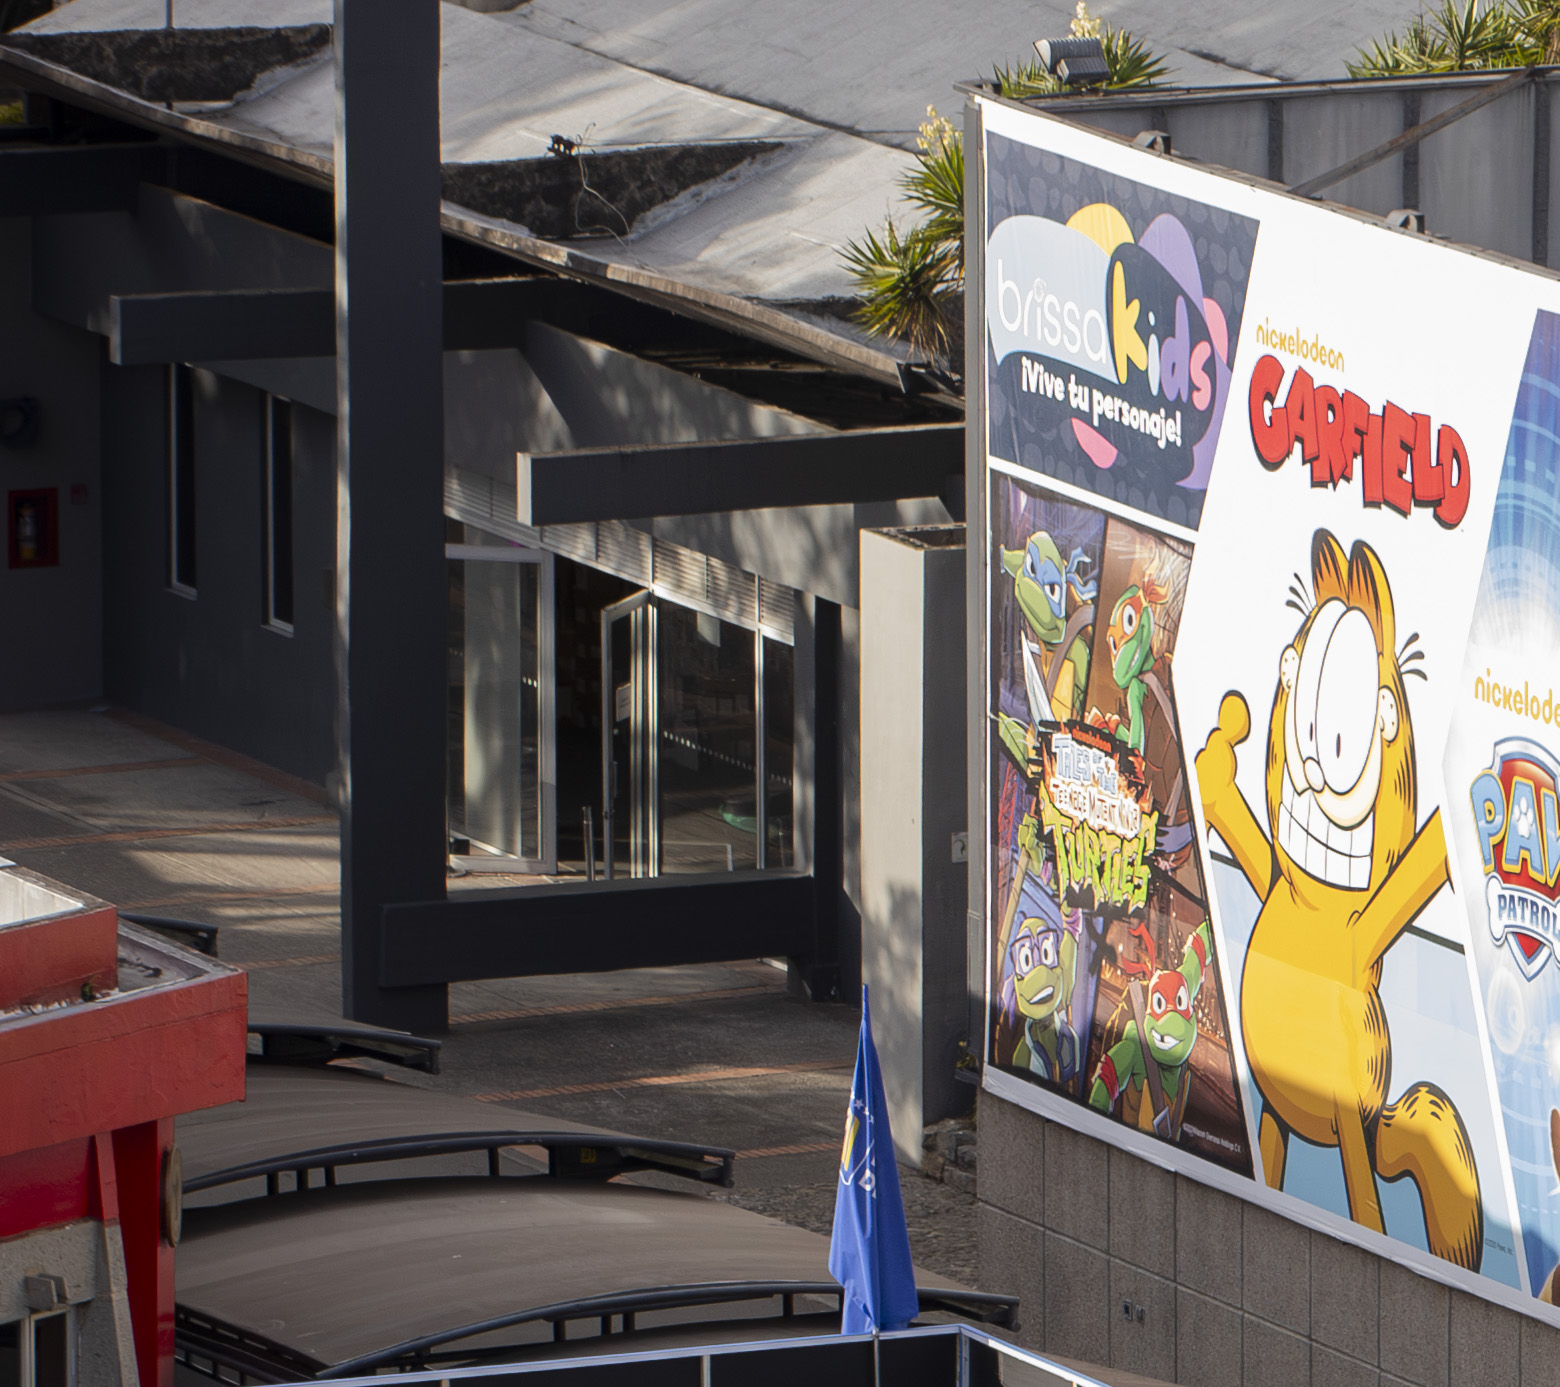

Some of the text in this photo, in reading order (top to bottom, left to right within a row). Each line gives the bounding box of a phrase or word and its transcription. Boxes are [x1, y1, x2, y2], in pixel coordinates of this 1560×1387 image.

[996, 258, 1212, 411] brissa kids
[1255, 316, 1345, 373] nickelodeon
[1093, 388, 1182, 447] personaje!
[1249, 354, 1471, 530] GARFIELD
[1041, 780, 1159, 915] TURTLES
[1498, 894, 1560, 942] PATROL
